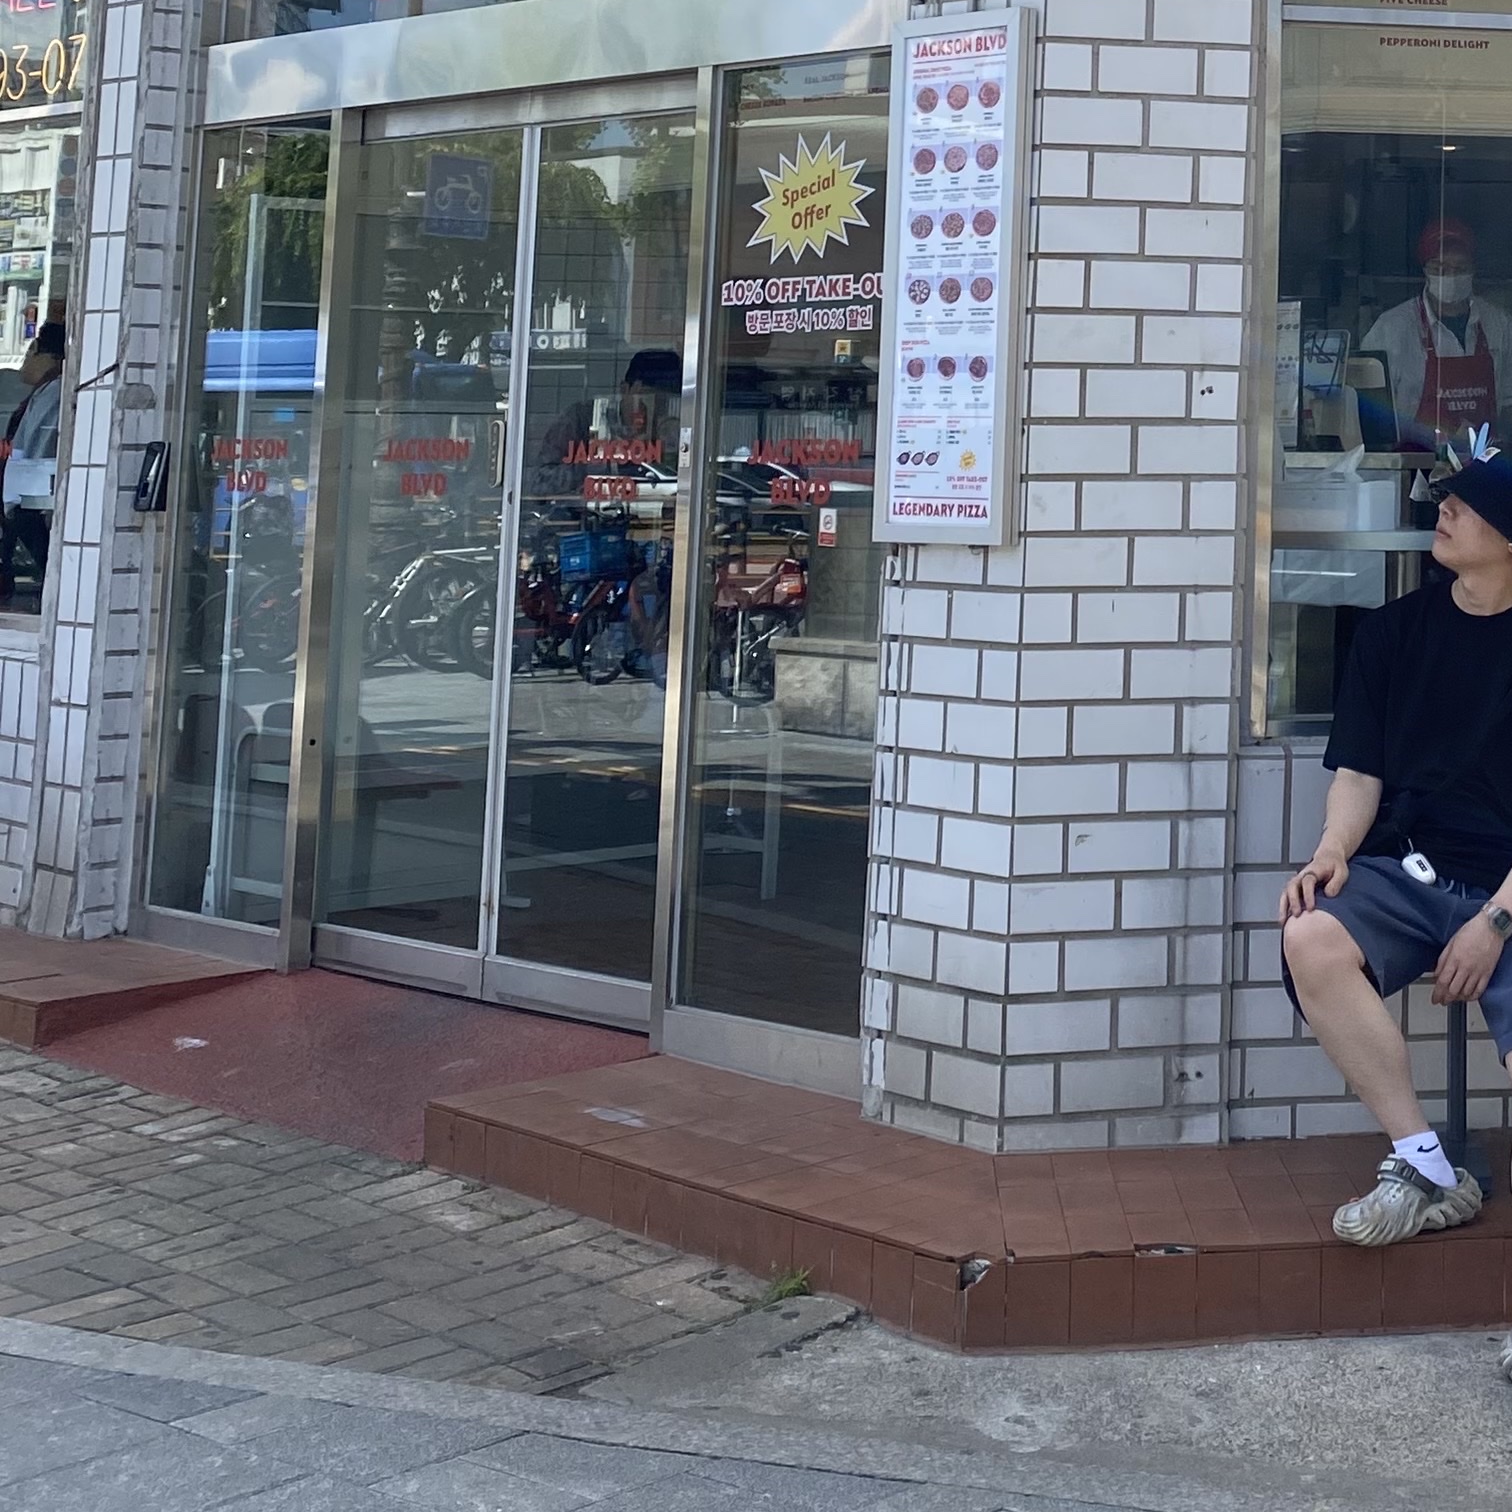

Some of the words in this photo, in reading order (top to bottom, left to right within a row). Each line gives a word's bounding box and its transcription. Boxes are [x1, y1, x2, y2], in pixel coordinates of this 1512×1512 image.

[912, 37, 972, 59] JACKSON
[975, 33, 1008, 53] BLVD
[1379, 37, 1441, 48] PEPPERONI
[1443, 39, 1490, 49] DELIGHT
[781, 169, 836, 209] Special
[791, 203, 832, 231] Offer
[722, 279, 764, 305] 10%
[766, 278, 801, 303] OFF
[747, 310, 770, 334] 방문
[772, 308, 797, 332] 포장
[798, 308, 812, 332] 시
[812, 308, 845, 331] 10%
[846, 305, 874, 330] 할인
[382, 438, 469, 462] JACKSON
[562, 439, 663, 465] JACKSON
[747, 437, 862, 466] JACKSON
[770, 477, 831, 505] BLVD
[892, 502, 955, 517] LEGENDARY
[957, 503, 988, 518] PIZZA
